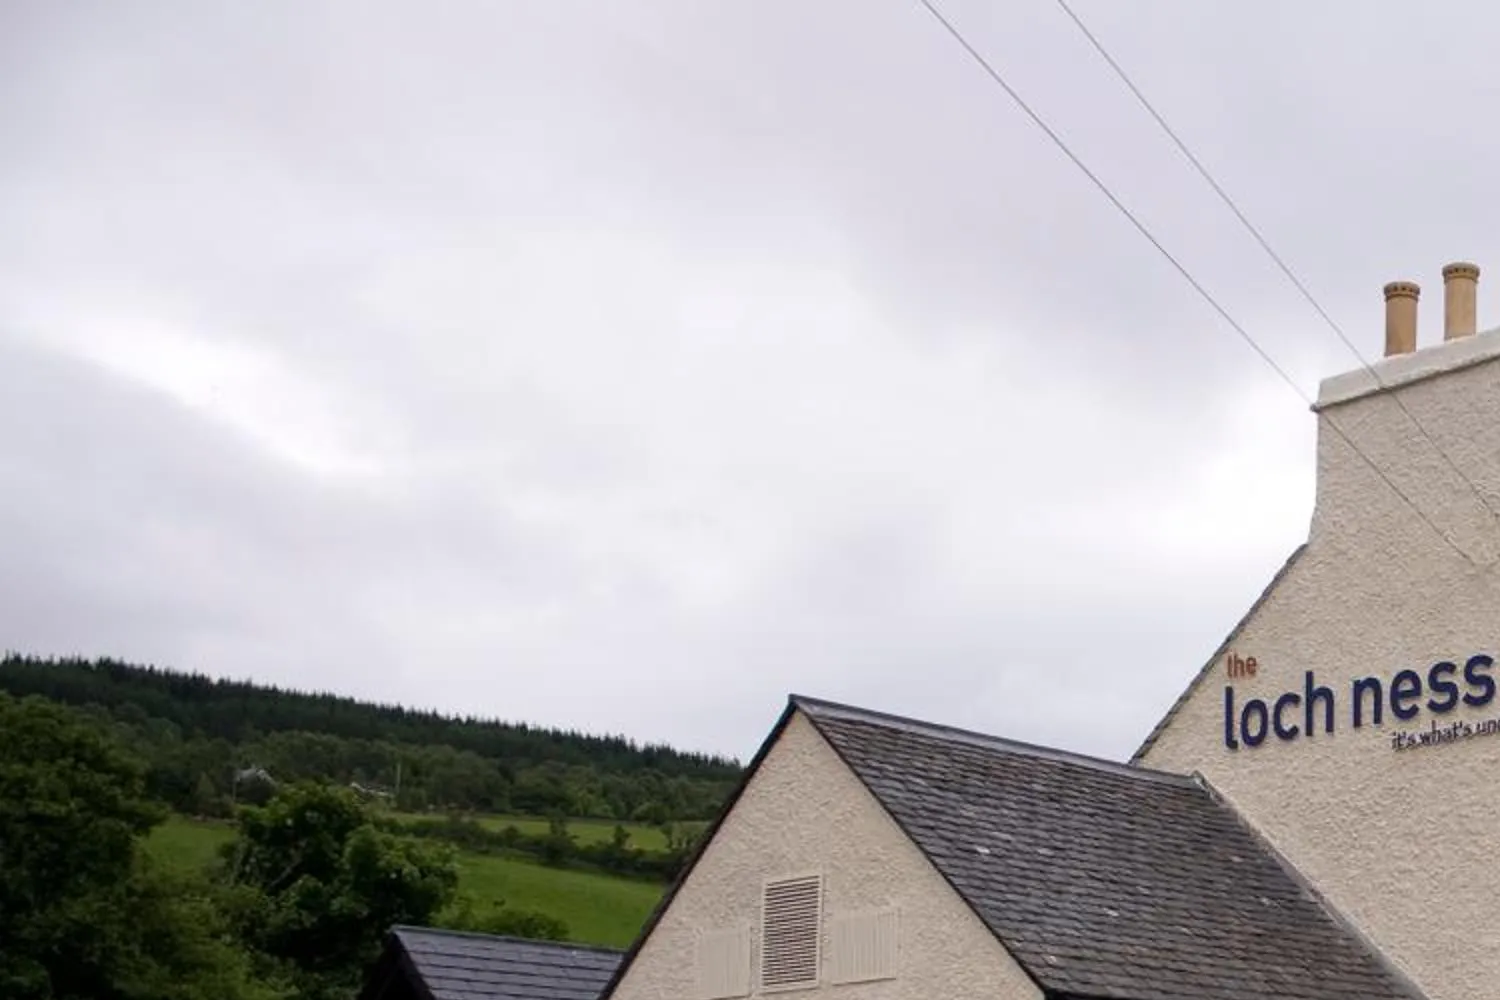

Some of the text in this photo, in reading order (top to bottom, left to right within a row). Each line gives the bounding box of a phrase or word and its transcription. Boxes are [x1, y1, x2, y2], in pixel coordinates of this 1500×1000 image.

[1227, 654, 1257, 678] the
[1224, 670, 1335, 749] loch
[1352, 654, 1496, 727] ness
[1391, 730, 1417, 750] it's
[1420, 720, 1472, 745] what's
